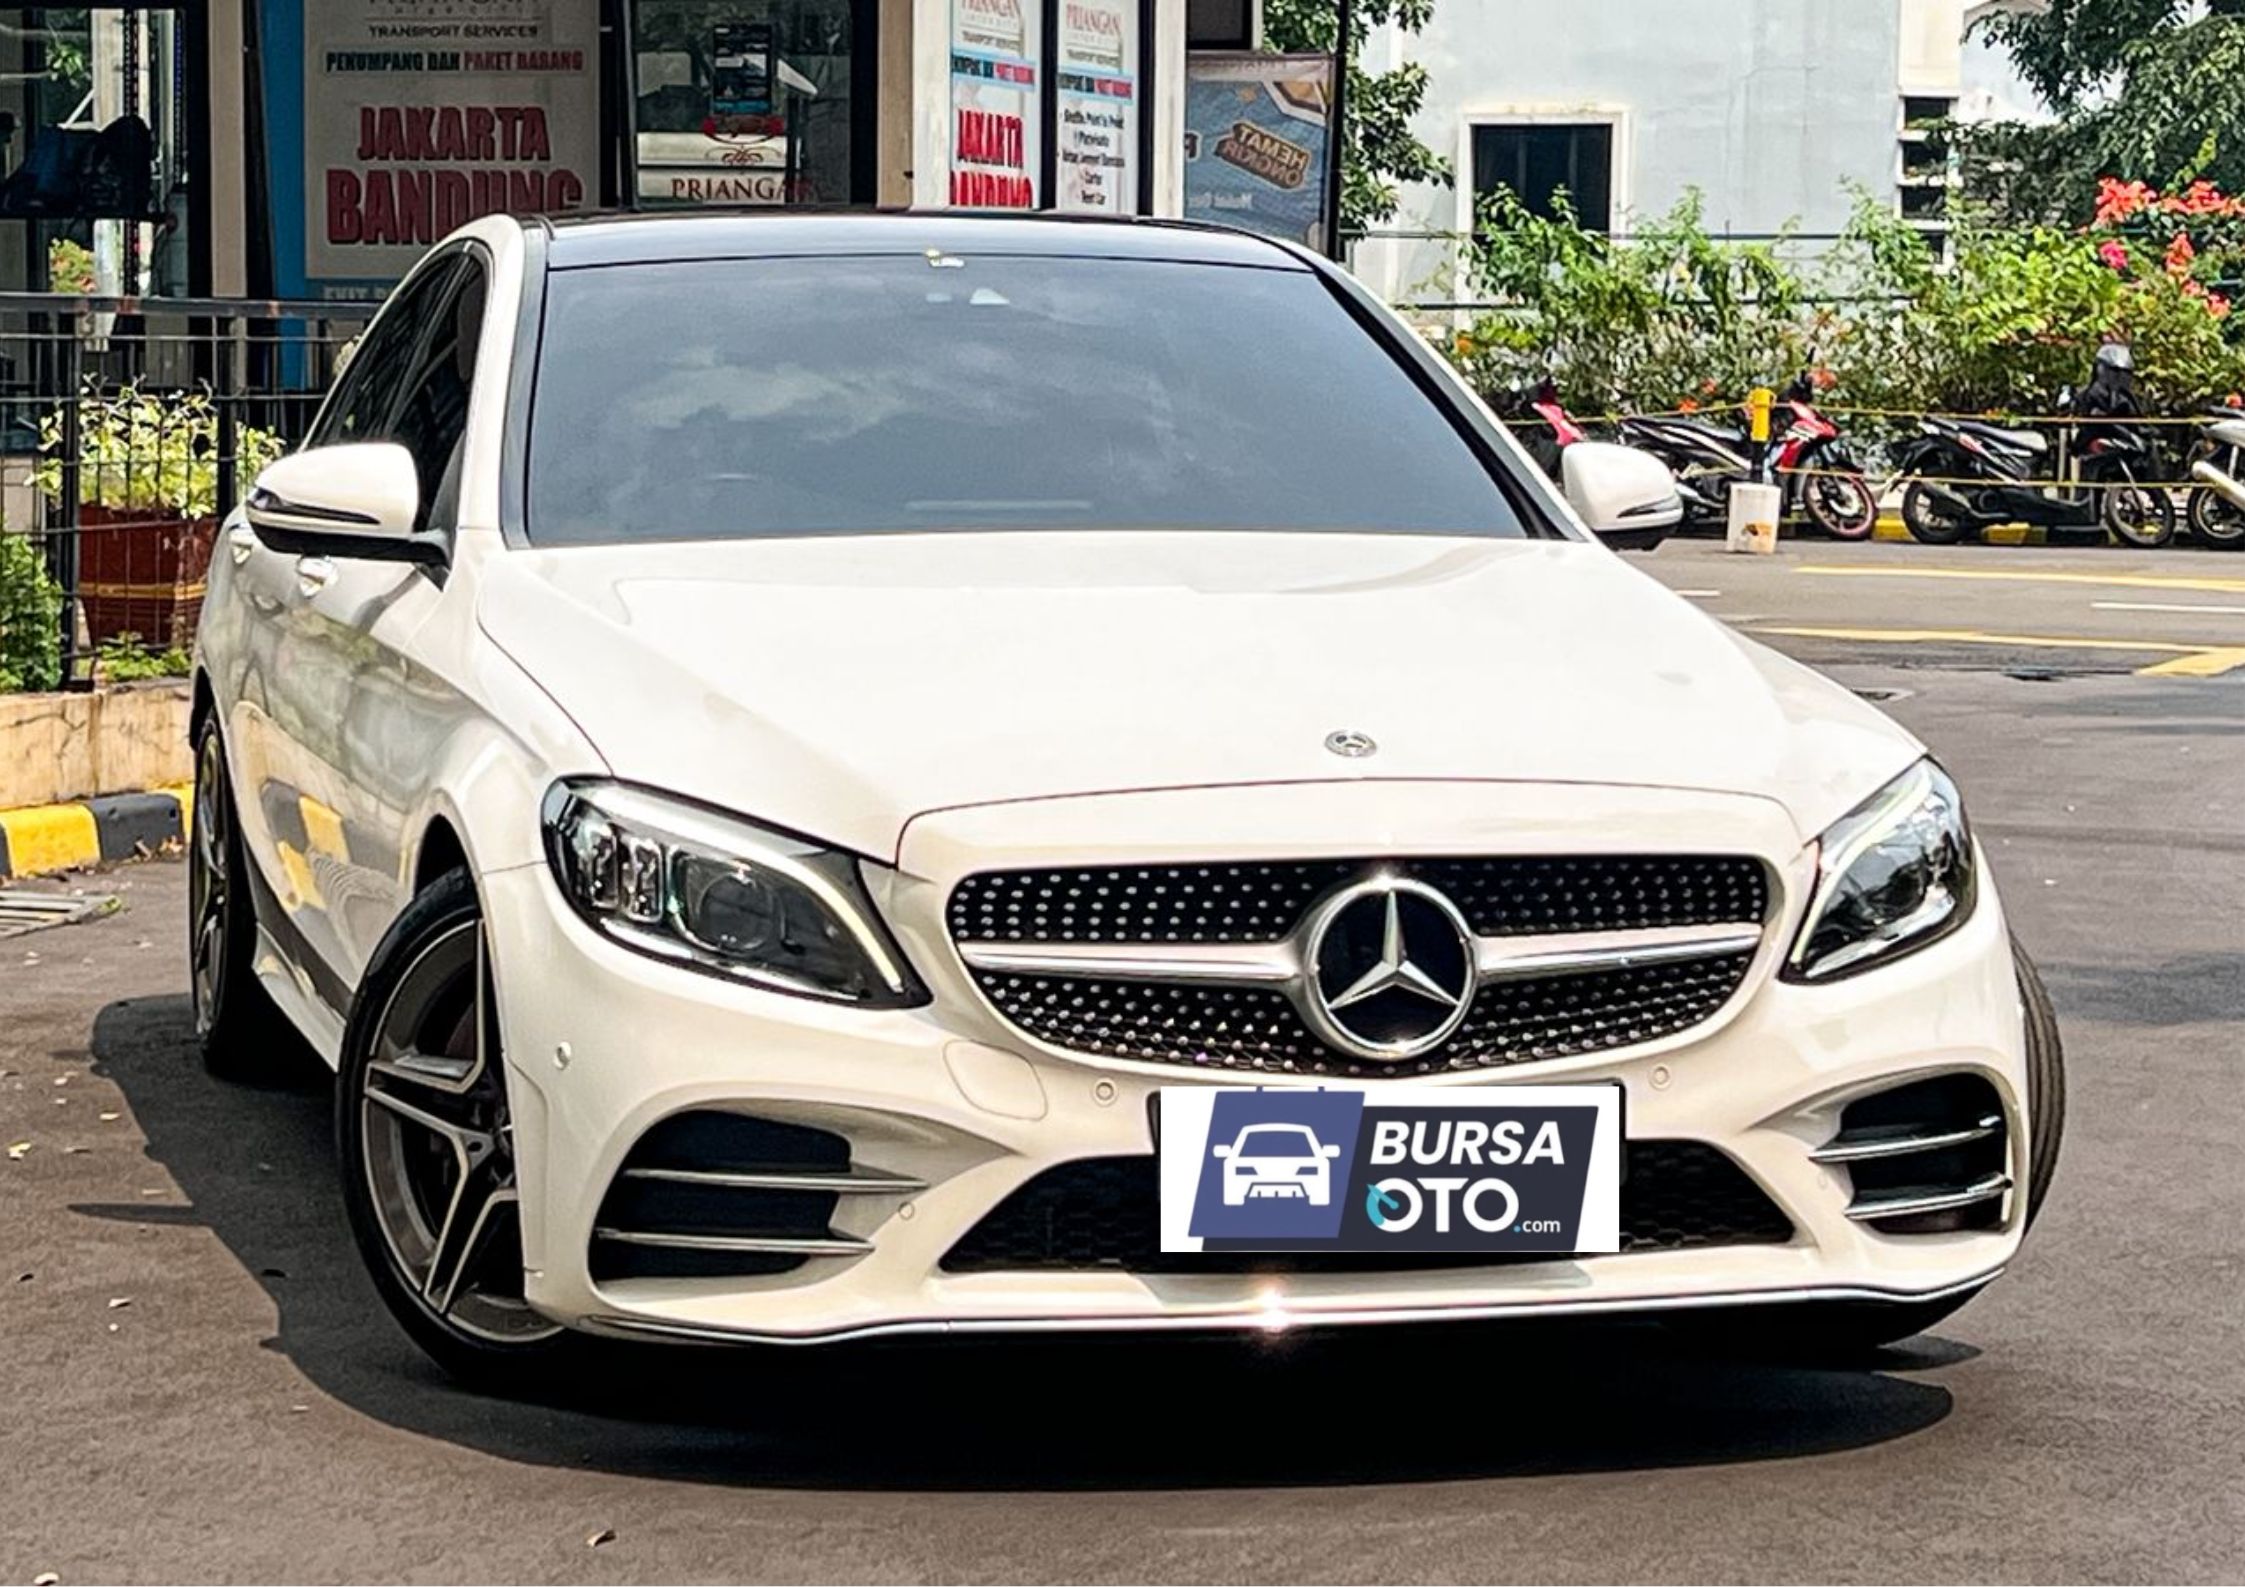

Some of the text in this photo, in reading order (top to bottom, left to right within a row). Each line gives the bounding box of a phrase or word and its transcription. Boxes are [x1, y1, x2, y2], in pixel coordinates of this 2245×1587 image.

[369, 25, 538, 38] TRANSPORT SERVICES
[325, 51, 424, 73] PENUMPANG
[463, 51, 514, 72] PAKET
[356, 106, 551, 161] JAKARTA
[957, 109, 1024, 169] JAKARTA
[325, 168, 583, 245] BANDUNG
